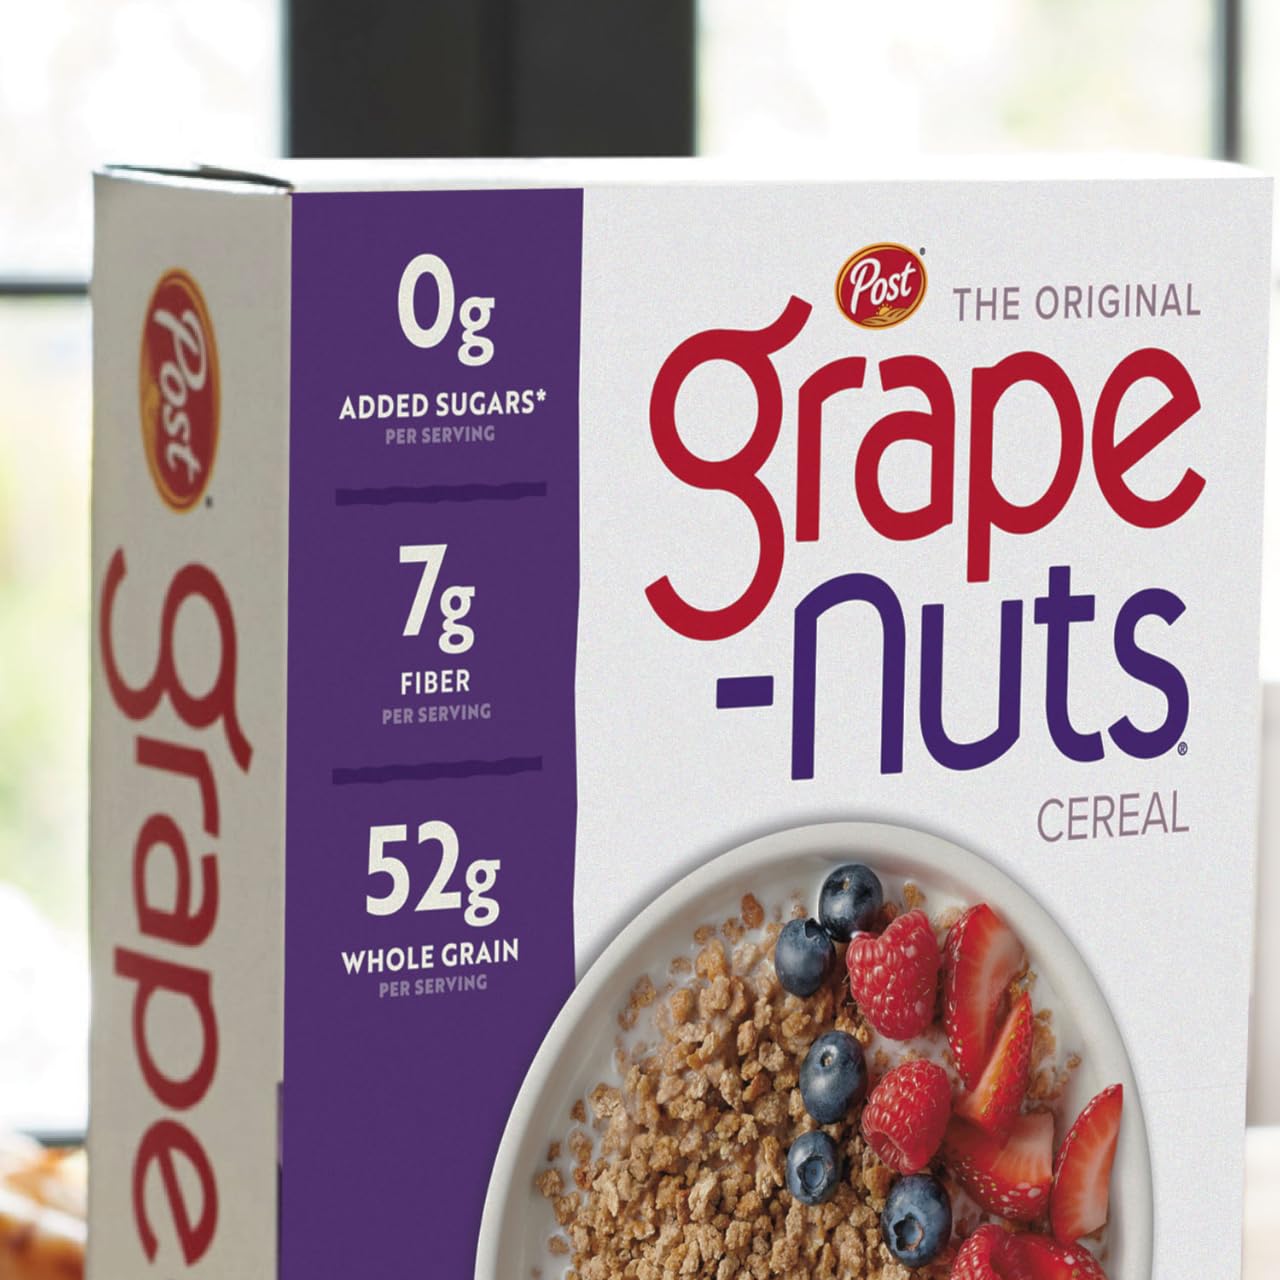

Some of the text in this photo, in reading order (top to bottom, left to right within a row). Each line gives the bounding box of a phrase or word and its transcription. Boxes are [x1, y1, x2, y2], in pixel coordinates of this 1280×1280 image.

[850, 258, 917, 315] Post
[953, 283, 1202, 322] THE ORIGINAL
[397, 253, 495, 367] 0g
[154, 309, 207, 483] Post
[339, 394, 428, 420] ADDED
[385, 424, 495, 445] PER SERVING
[644, 295, 1206, 641] grape
[399, 544, 475, 654] 7g
[401, 669, 471, 695] FIBER
[382, 703, 491, 725] PER SERVING
[1037, 790, 1190, 843] CEREAL
[365, 819, 501, 927] 52g
[341, 938, 520, 975] WHOLE GRAIN
[379, 973, 488, 998] PER SERVING
